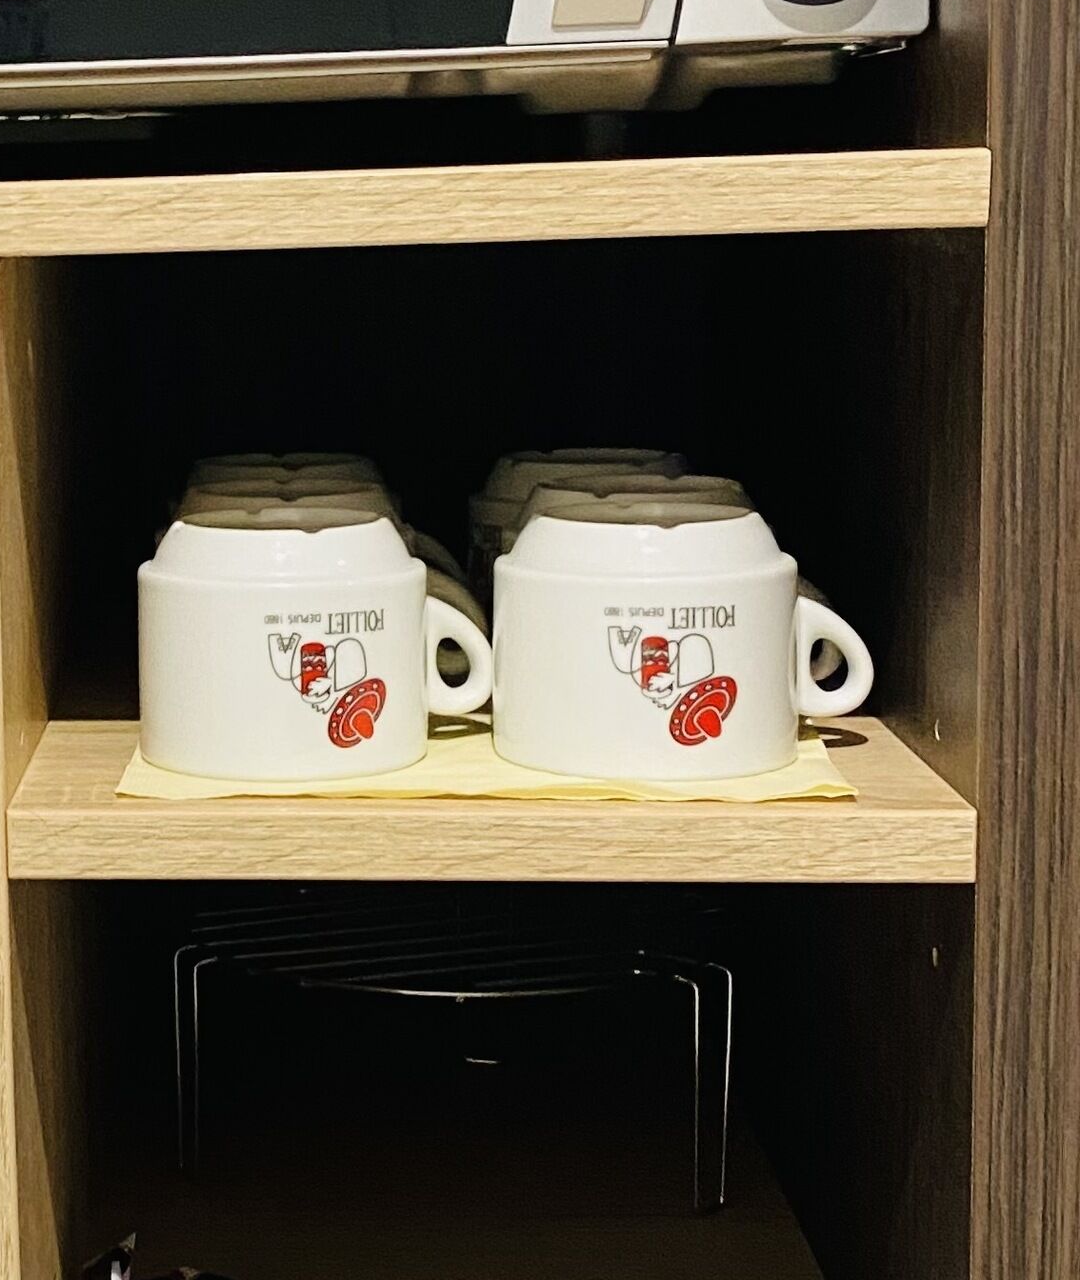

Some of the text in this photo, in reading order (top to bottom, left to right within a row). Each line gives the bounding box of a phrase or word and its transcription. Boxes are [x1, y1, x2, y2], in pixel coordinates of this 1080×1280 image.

[288, 612, 321, 625] DEPUIS
[628, 606, 664, 617] DEPUIS
[668, 605, 736, 630] FOLLIET
[324, 608, 385, 635] FOLLIET
